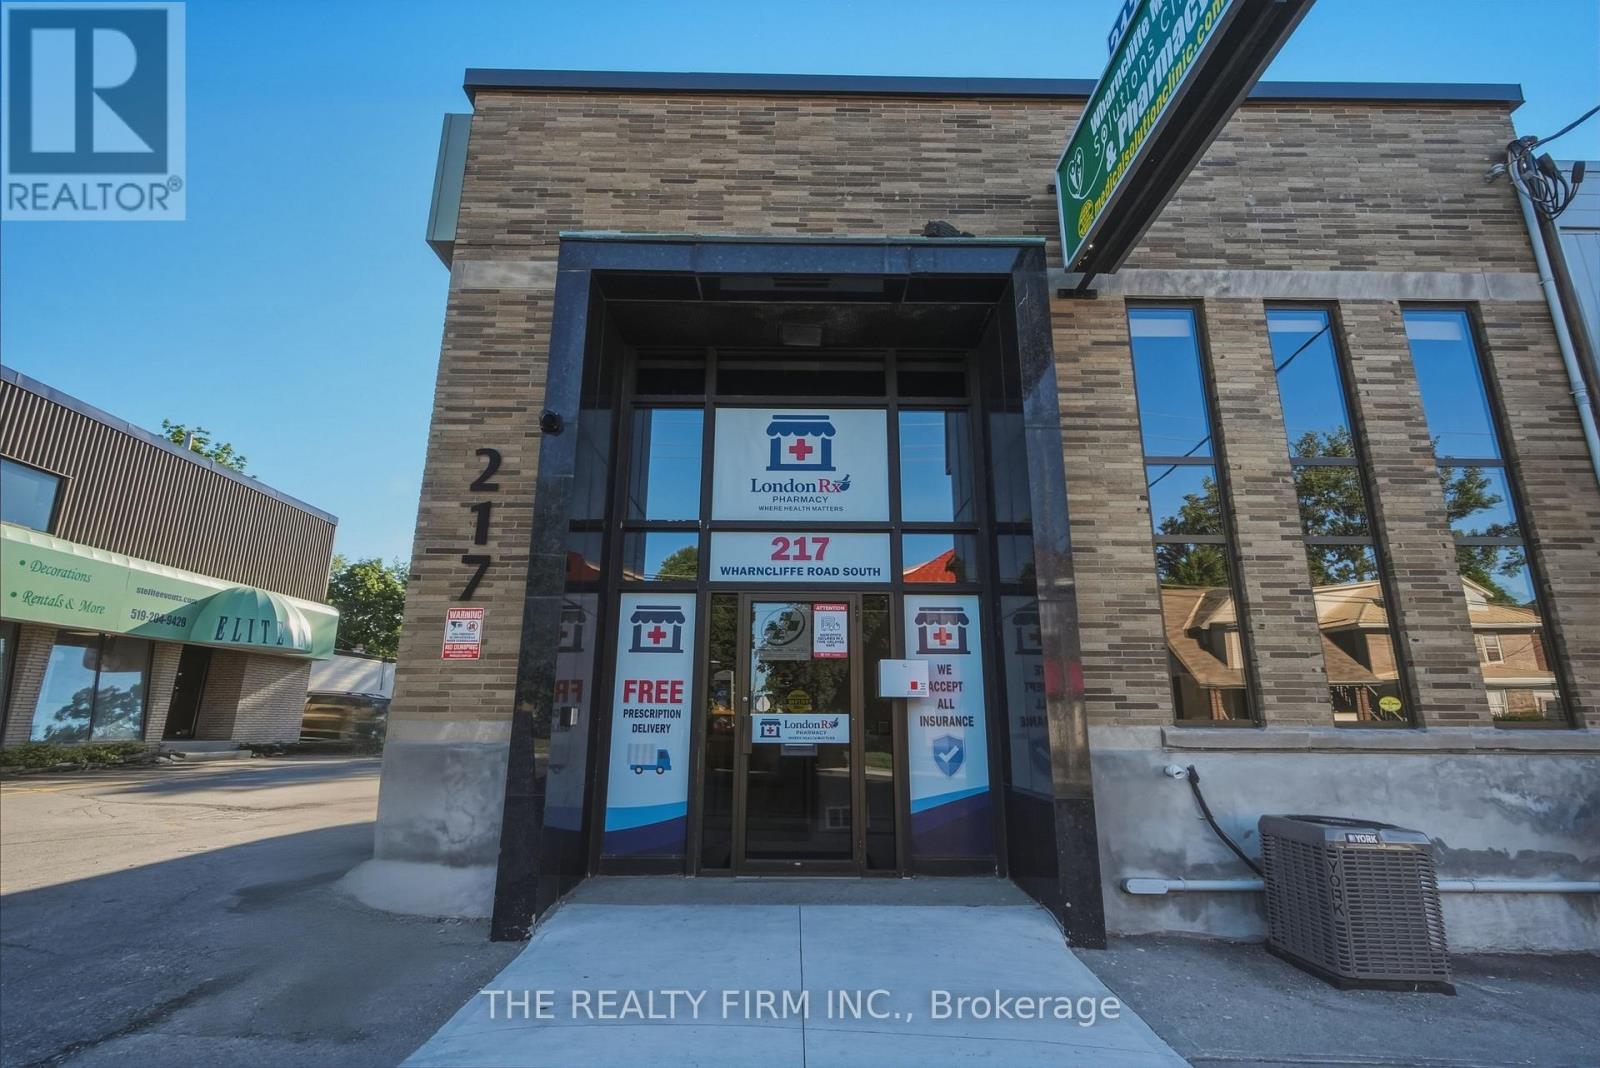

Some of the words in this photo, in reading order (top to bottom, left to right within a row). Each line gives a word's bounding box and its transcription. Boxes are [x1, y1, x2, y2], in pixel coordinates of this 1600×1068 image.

[1090, 16, 1149, 135] Wharncliffe
[1094, 38, 1154, 157] Solutions
[1106, 141, 1117, 171] &
[771, 536, 830, 561] 217
[30, 560, 92, 583] Decorations
[720, 566, 803, 576] WHARNCLIFFE
[807, 567, 839, 576] ROAD
[843, 567, 881, 576] SOUTH
[21, 590, 64, 607] Rentals
[65, 598, 74, 610] &
[78, 600, 106, 614] More
[449, 610, 482, 619] WARNING
[936, 664, 952, 675] WE
[623, 680, 684, 704] FREE
[929, 681, 963, 692] ACCEPT
[937, 698, 955, 709] ALL
[623, 708, 681, 719] PRESCRIPTION
[919, 715, 974, 727] INSURANCE
[632, 723, 671, 734] DELIVERY
[1355, 834, 1378, 843] YORK
[1328, 860, 1344, 917] YORK
